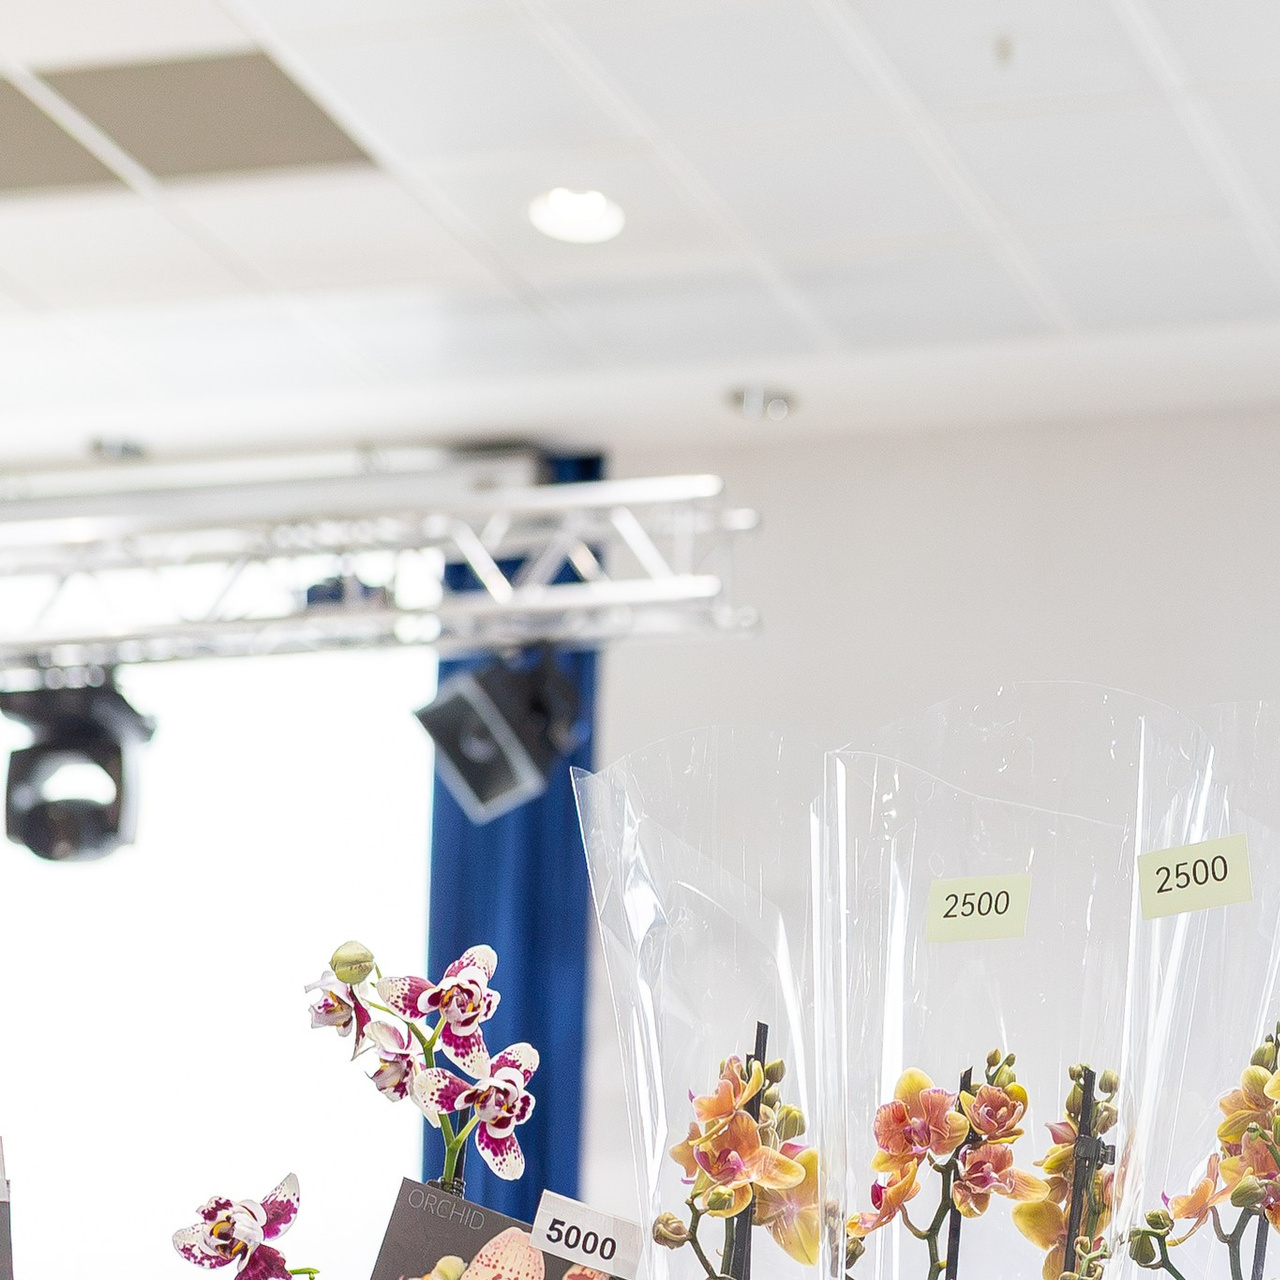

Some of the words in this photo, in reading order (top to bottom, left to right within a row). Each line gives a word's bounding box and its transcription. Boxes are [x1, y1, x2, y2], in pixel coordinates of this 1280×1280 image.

[1155, 855, 1228, 894] 2500
[942, 890, 1011, 919] 2500
[407, 1187, 486, 1231] ORCHID
[545, 1217, 617, 1261] 5000
